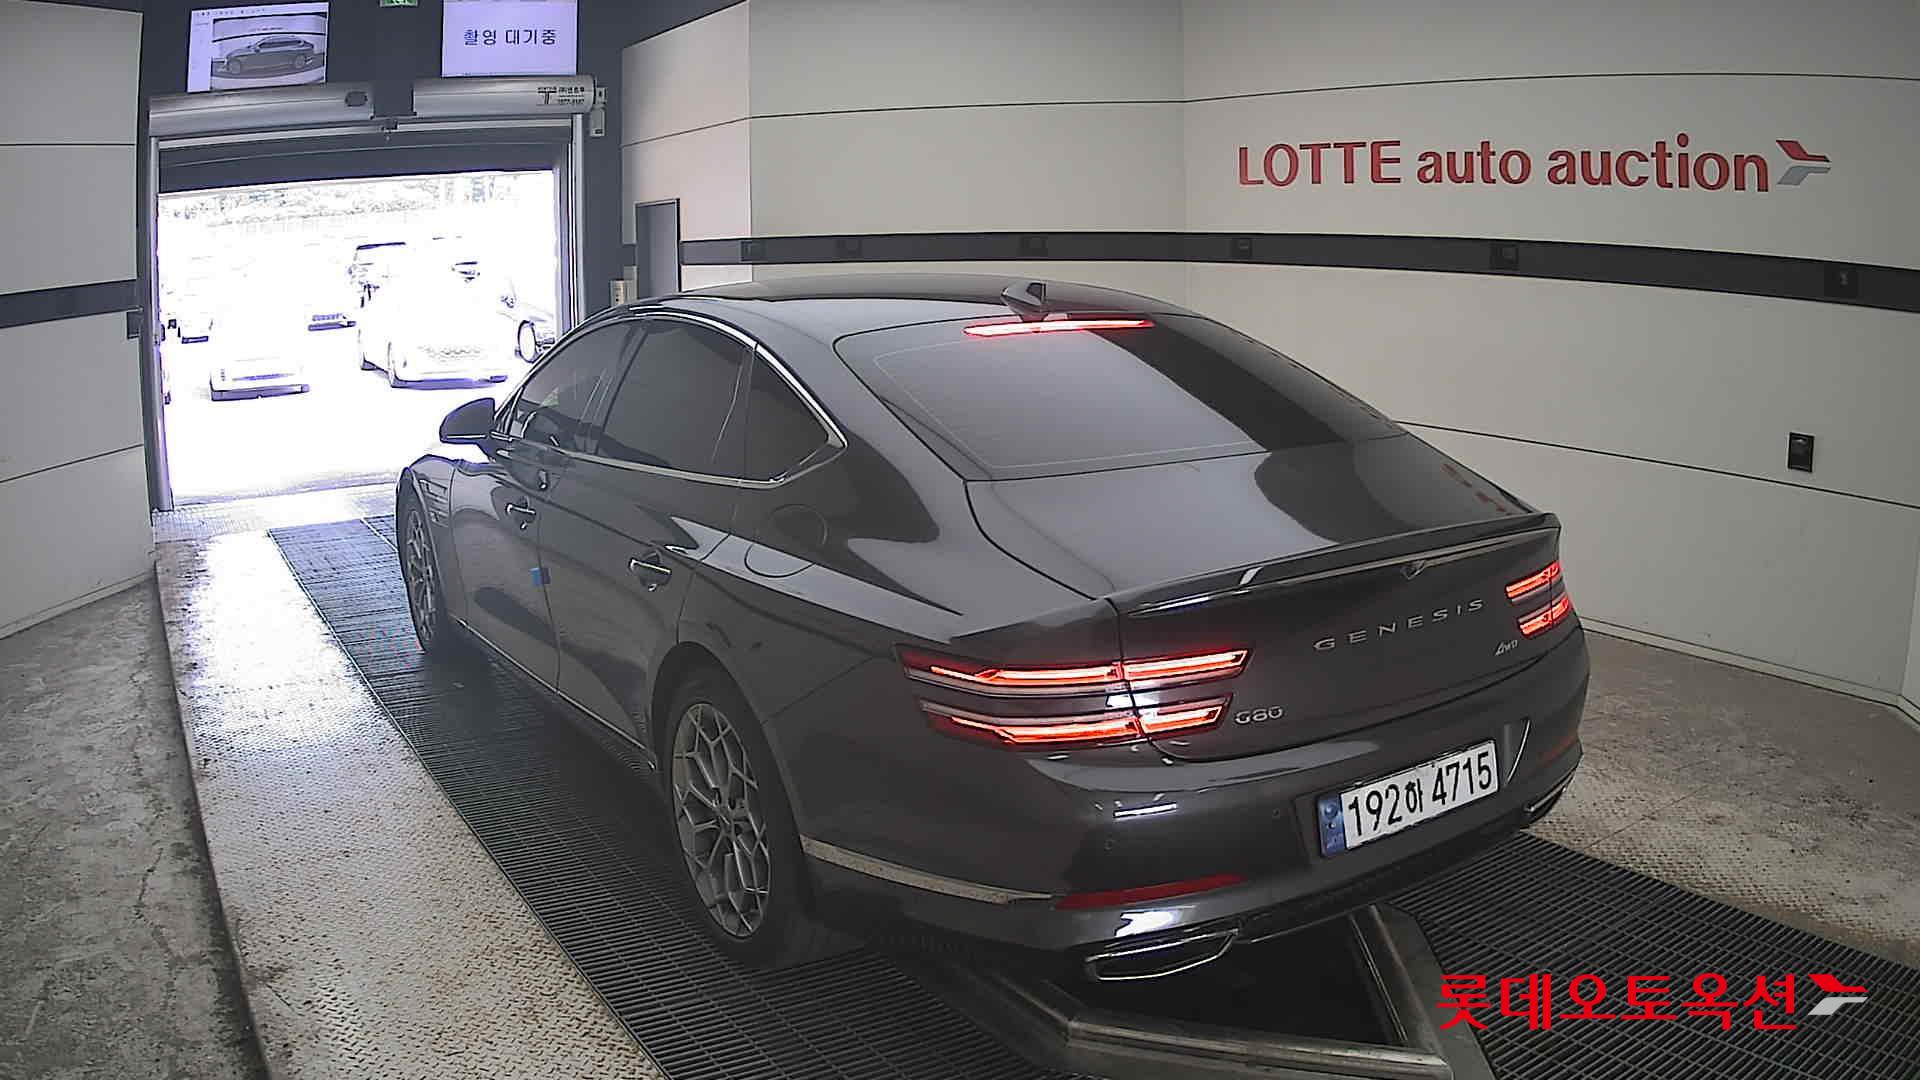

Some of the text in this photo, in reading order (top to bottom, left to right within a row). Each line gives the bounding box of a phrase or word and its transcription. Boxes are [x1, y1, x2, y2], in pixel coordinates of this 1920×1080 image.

[463, 29, 557, 46] 촬영 대기중
[1239, 132, 1769, 192] LOTTE auto auction
[1312, 598, 1483, 651] GENESIS
[1235, 705, 1283, 724] G80
[1348, 751, 1493, 837] 192하 4715
